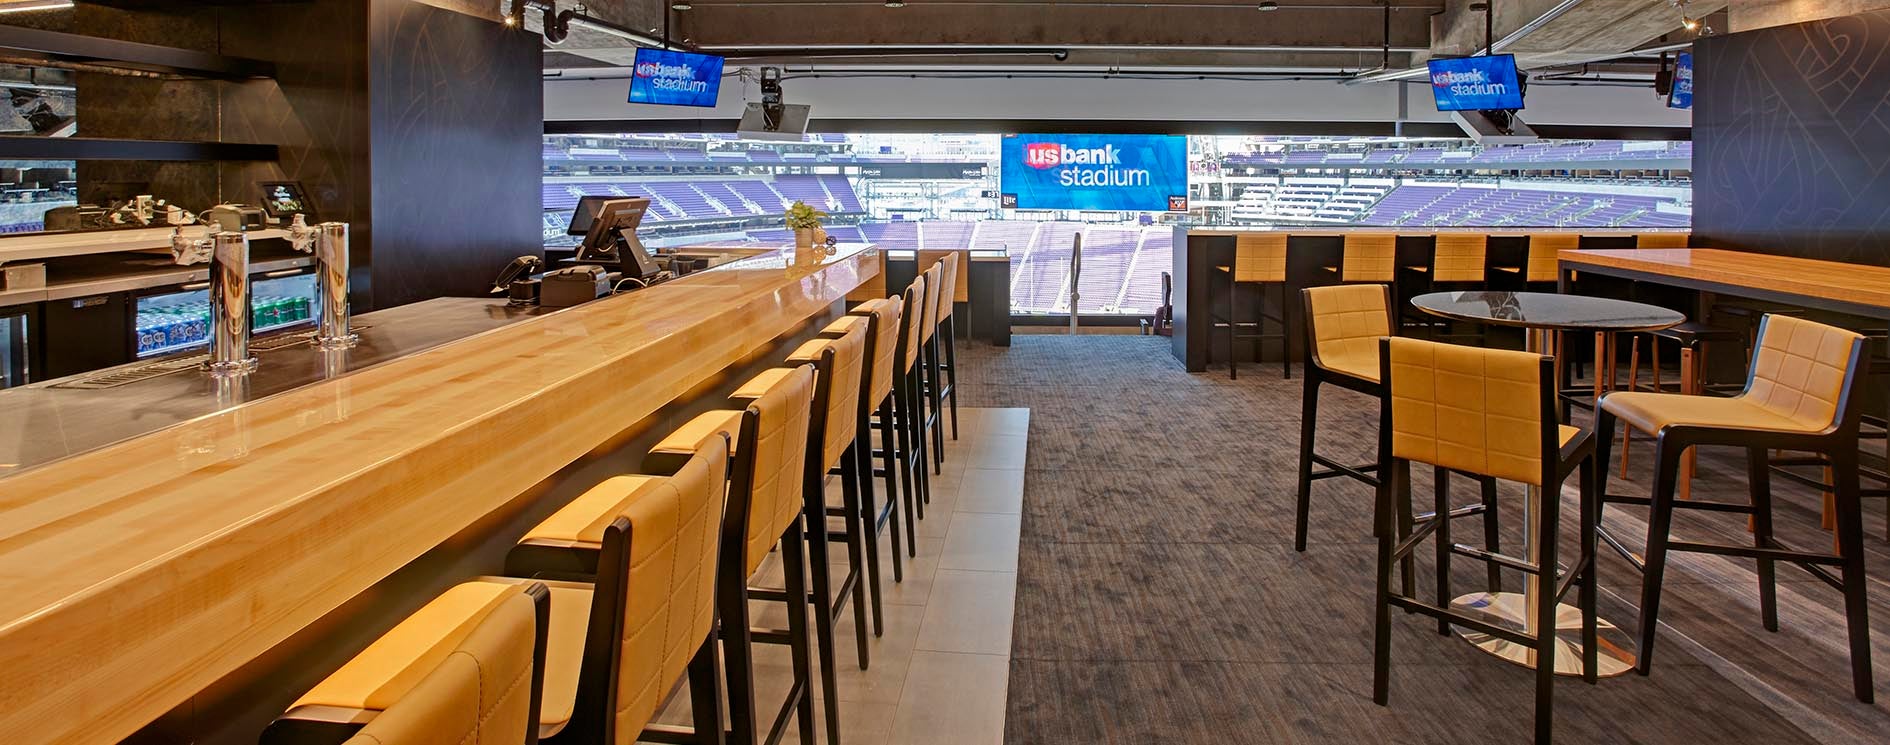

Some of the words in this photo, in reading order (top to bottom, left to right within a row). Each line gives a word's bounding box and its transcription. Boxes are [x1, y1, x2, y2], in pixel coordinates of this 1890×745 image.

[652, 76, 706, 92] stadium
[1450, 81, 1506, 96] stadium
[1060, 165, 1150, 187] stadium
